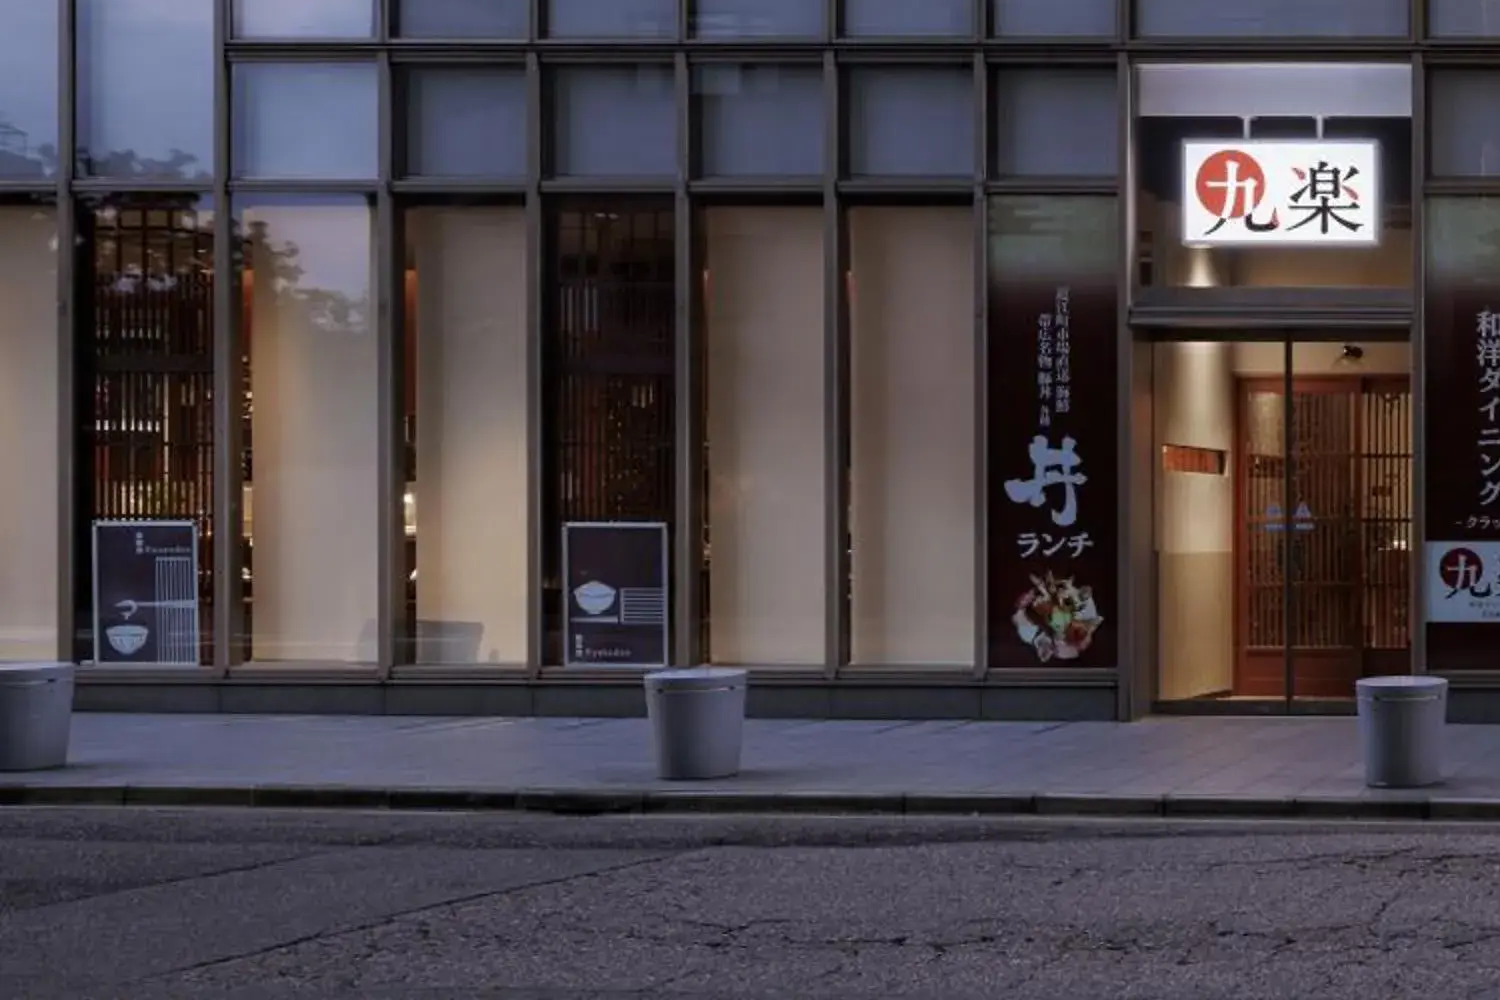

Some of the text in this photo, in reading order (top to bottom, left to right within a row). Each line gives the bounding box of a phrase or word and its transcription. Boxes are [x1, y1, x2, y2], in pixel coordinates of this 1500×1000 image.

[1202, 156, 1365, 236] 九楽
[1016, 531, 1095, 558] ランチ
